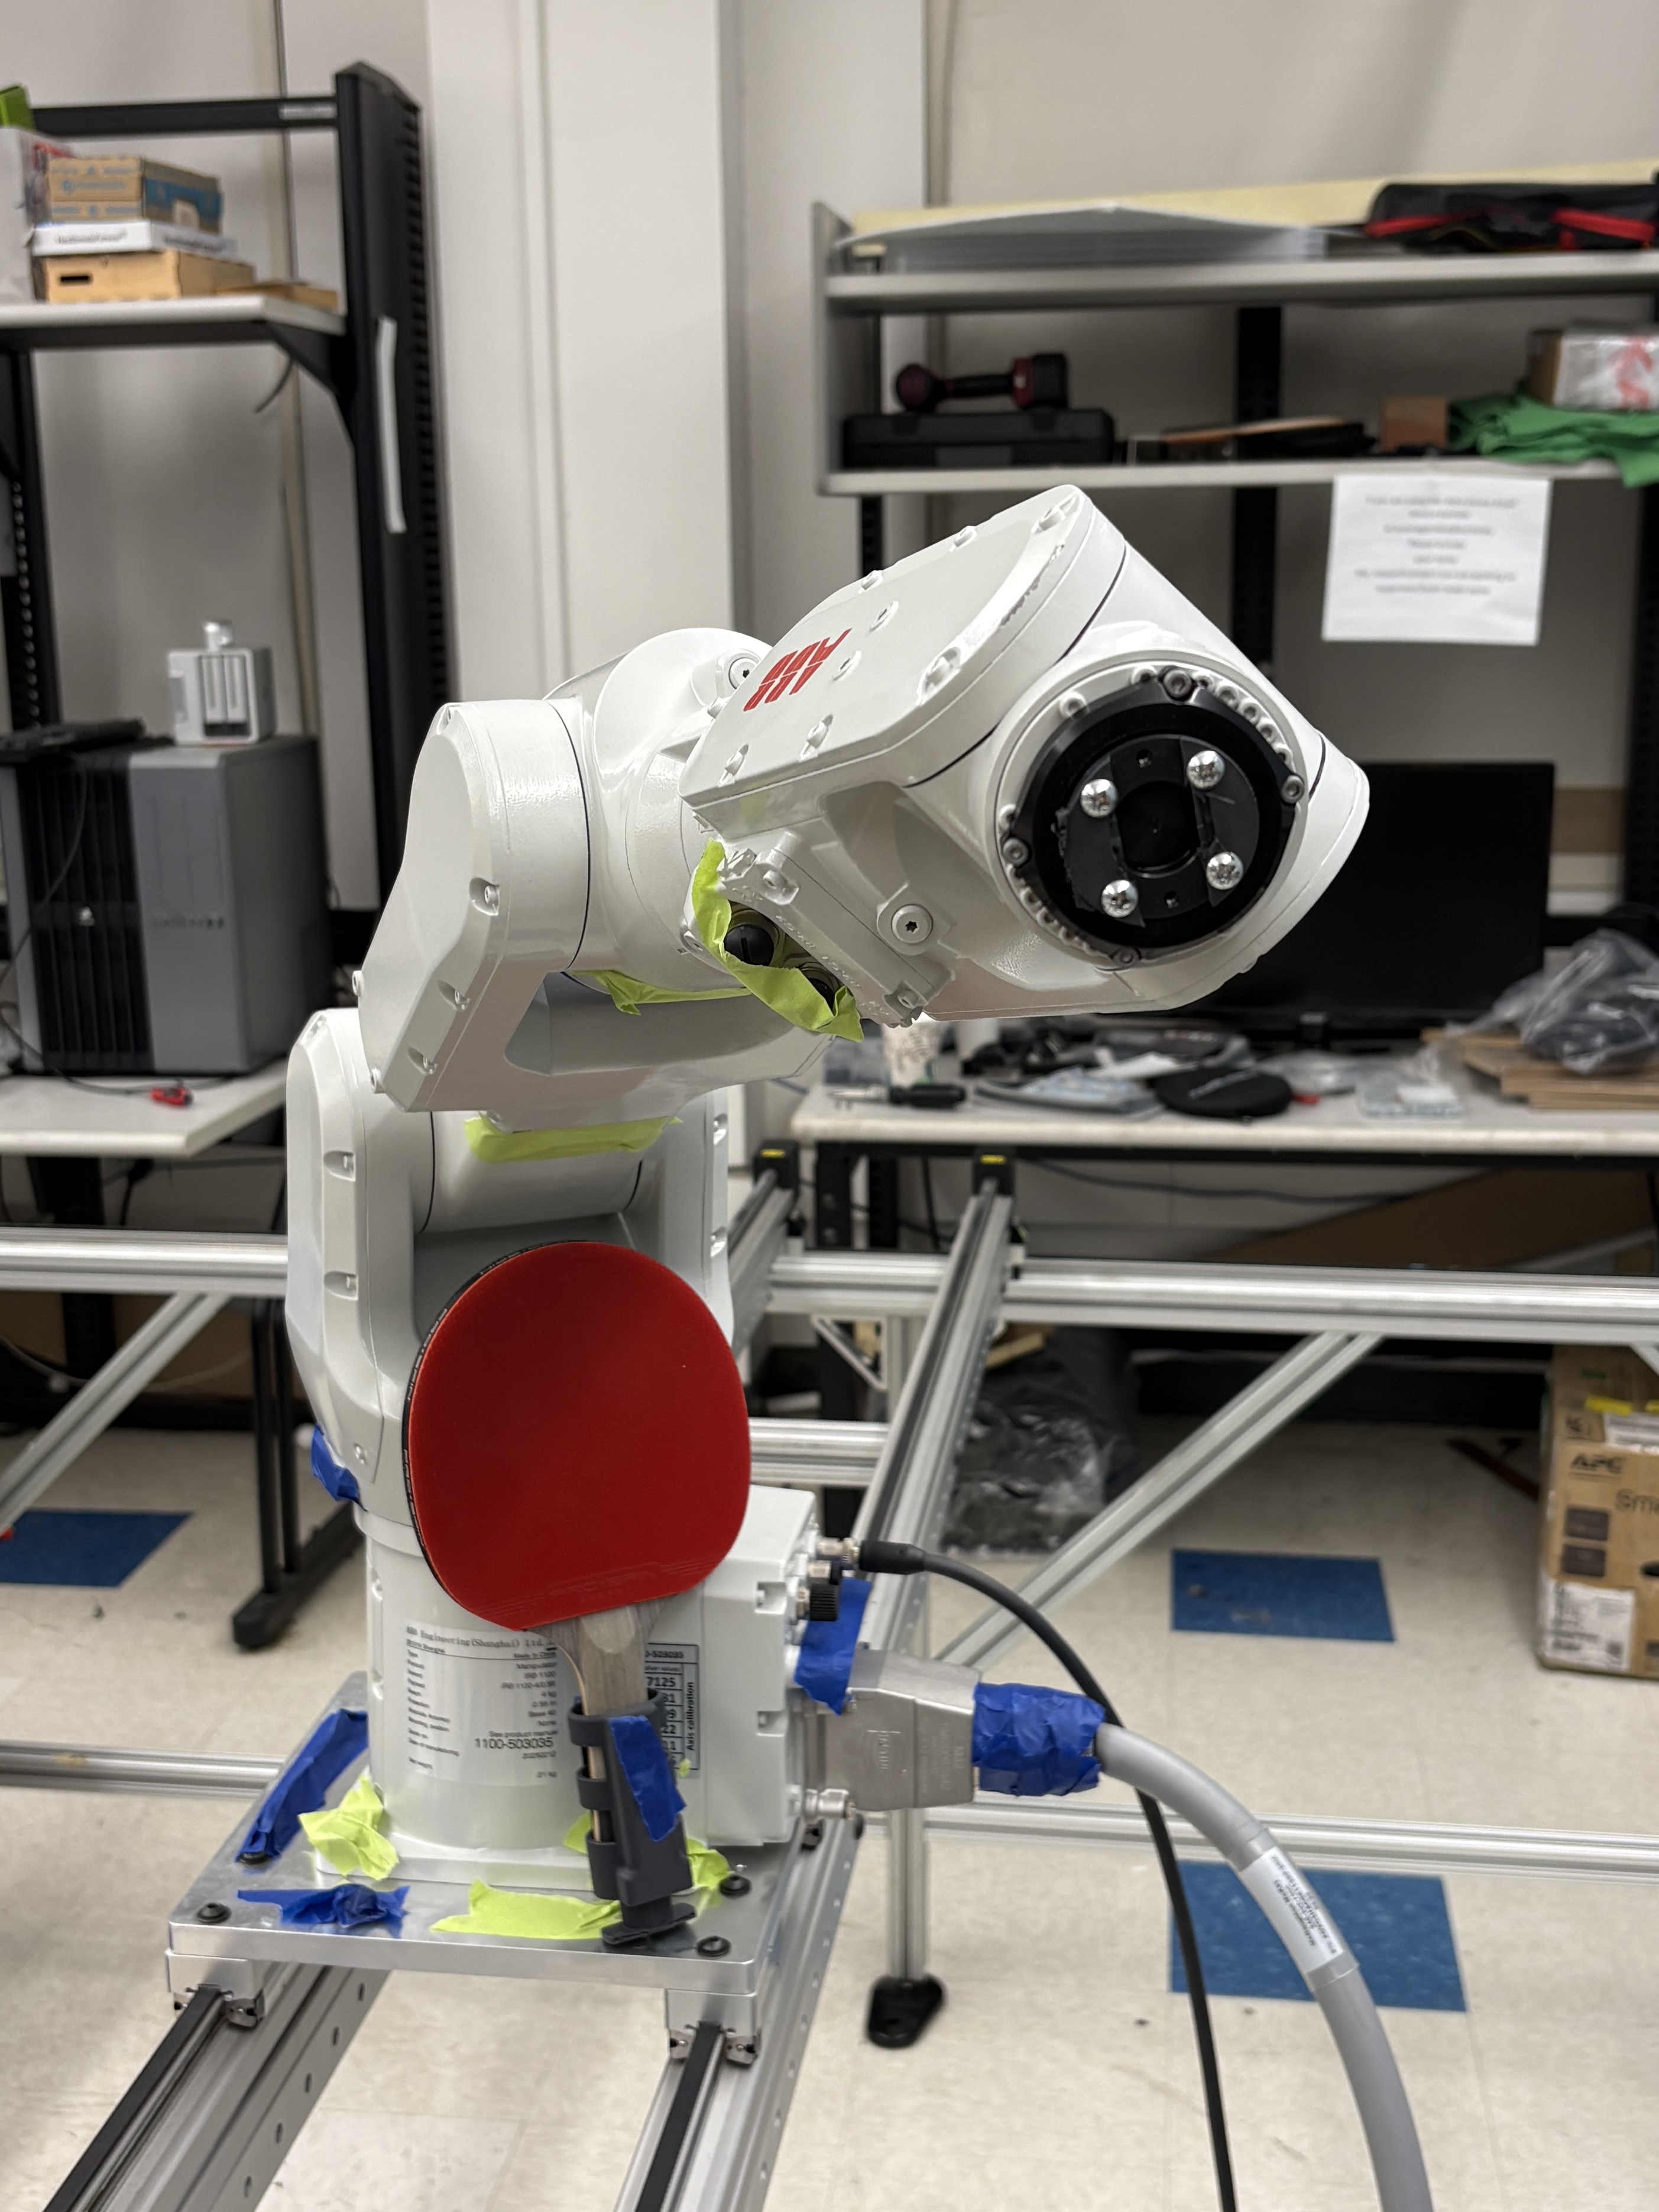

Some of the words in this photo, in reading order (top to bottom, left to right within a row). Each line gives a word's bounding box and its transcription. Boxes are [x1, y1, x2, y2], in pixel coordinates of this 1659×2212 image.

[743, 628, 852, 711] ABB
[1571, 1453, 1622, 1475] APC
[645, 1650, 685, 1659] 0-503035
[646, 1676, 676, 1687] 7125
[685, 1682, 695, 1731] calibration
[667, 1709, 676, 1718] 9
[662, 1724, 676, 1734] 22
[474, 1737, 554, 1749] 1100-503035
[686, 1732, 695, 1751] Axis
